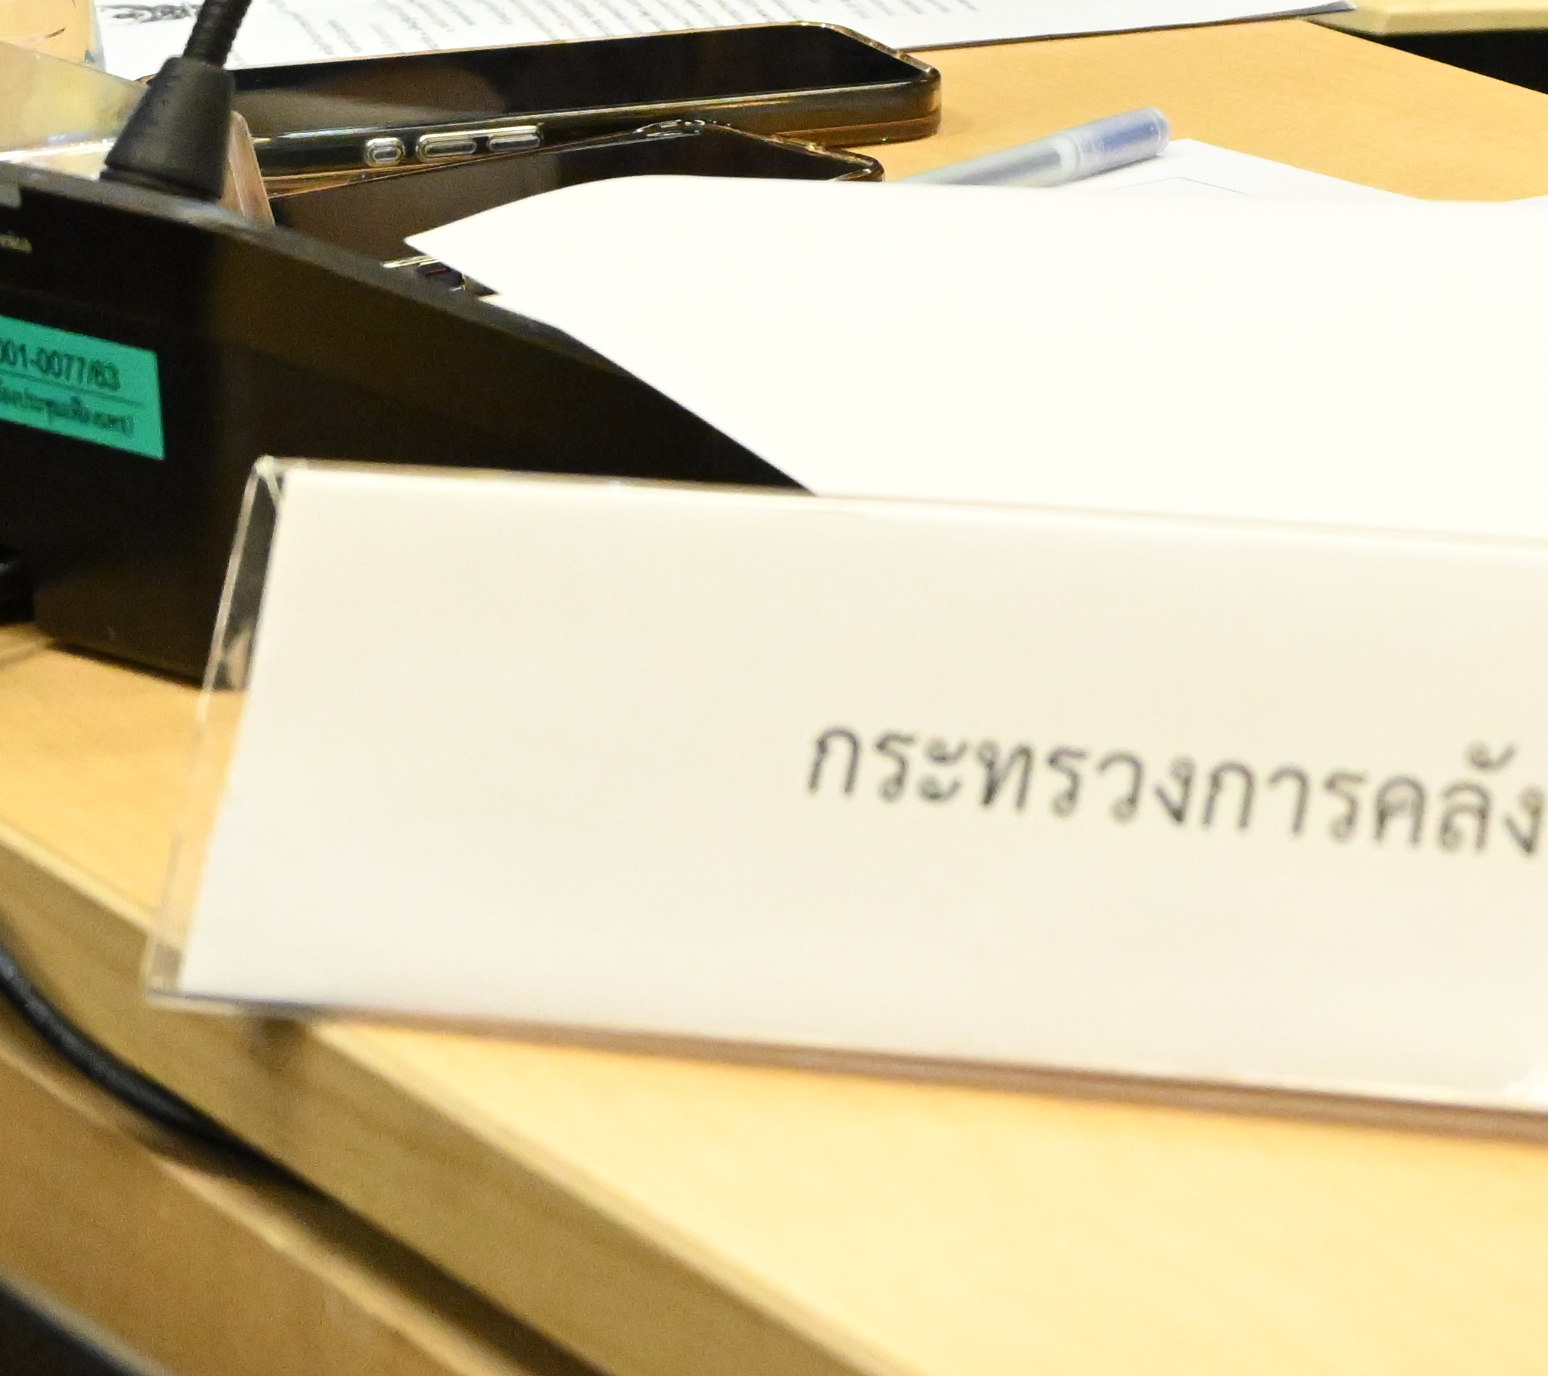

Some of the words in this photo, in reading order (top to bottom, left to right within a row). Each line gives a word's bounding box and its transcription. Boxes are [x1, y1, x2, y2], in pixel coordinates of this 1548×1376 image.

[805, 723, 1548, 858] กระทรวงการคลัง
